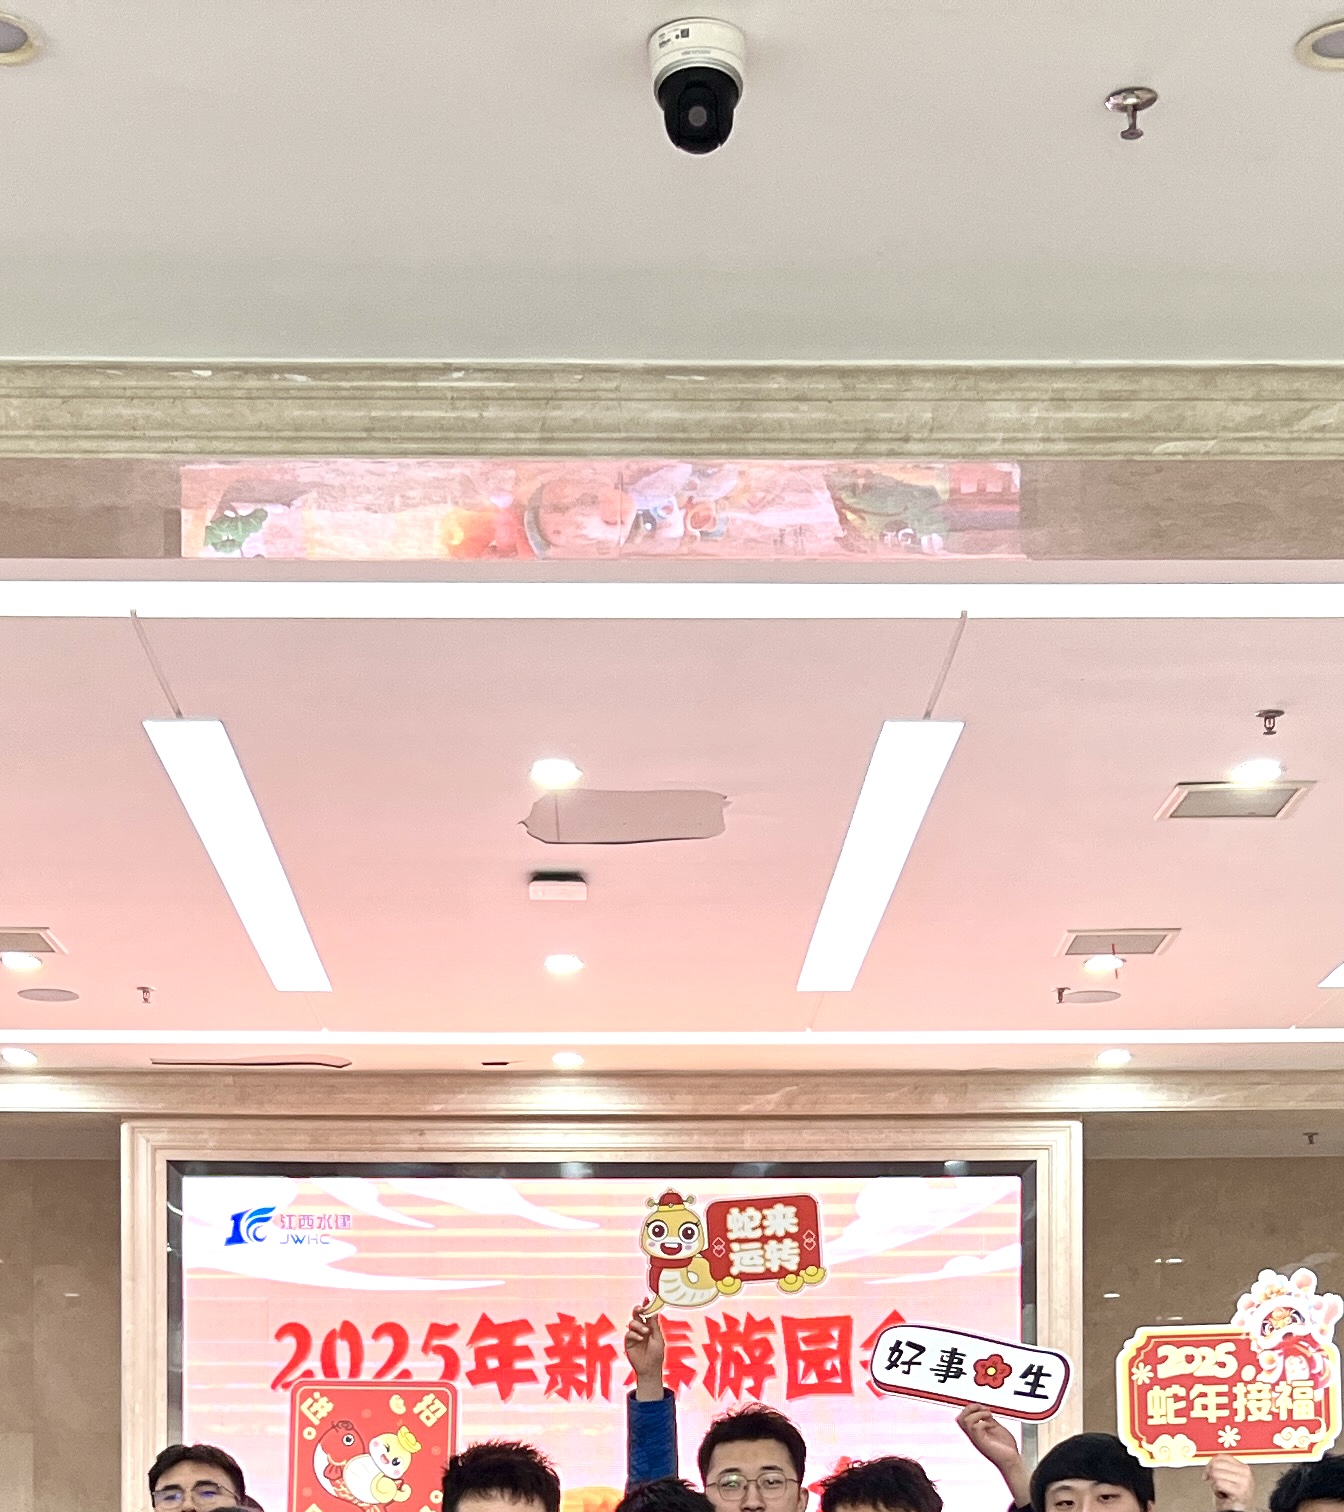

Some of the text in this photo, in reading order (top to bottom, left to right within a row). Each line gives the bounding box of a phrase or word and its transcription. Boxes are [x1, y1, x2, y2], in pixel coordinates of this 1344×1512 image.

[279, 1213, 352, 1231] 江西水建
[280, 1233, 331, 1245] JWHC
[727, 1203, 799, 1240] 蛇来
[729, 1238, 800, 1276] 运转
[271, 1309, 908, 1402] 2025年新游园
[413, 1393, 447, 1427] 招
[1147, 1380, 1315, 1426] 蛇年接福
